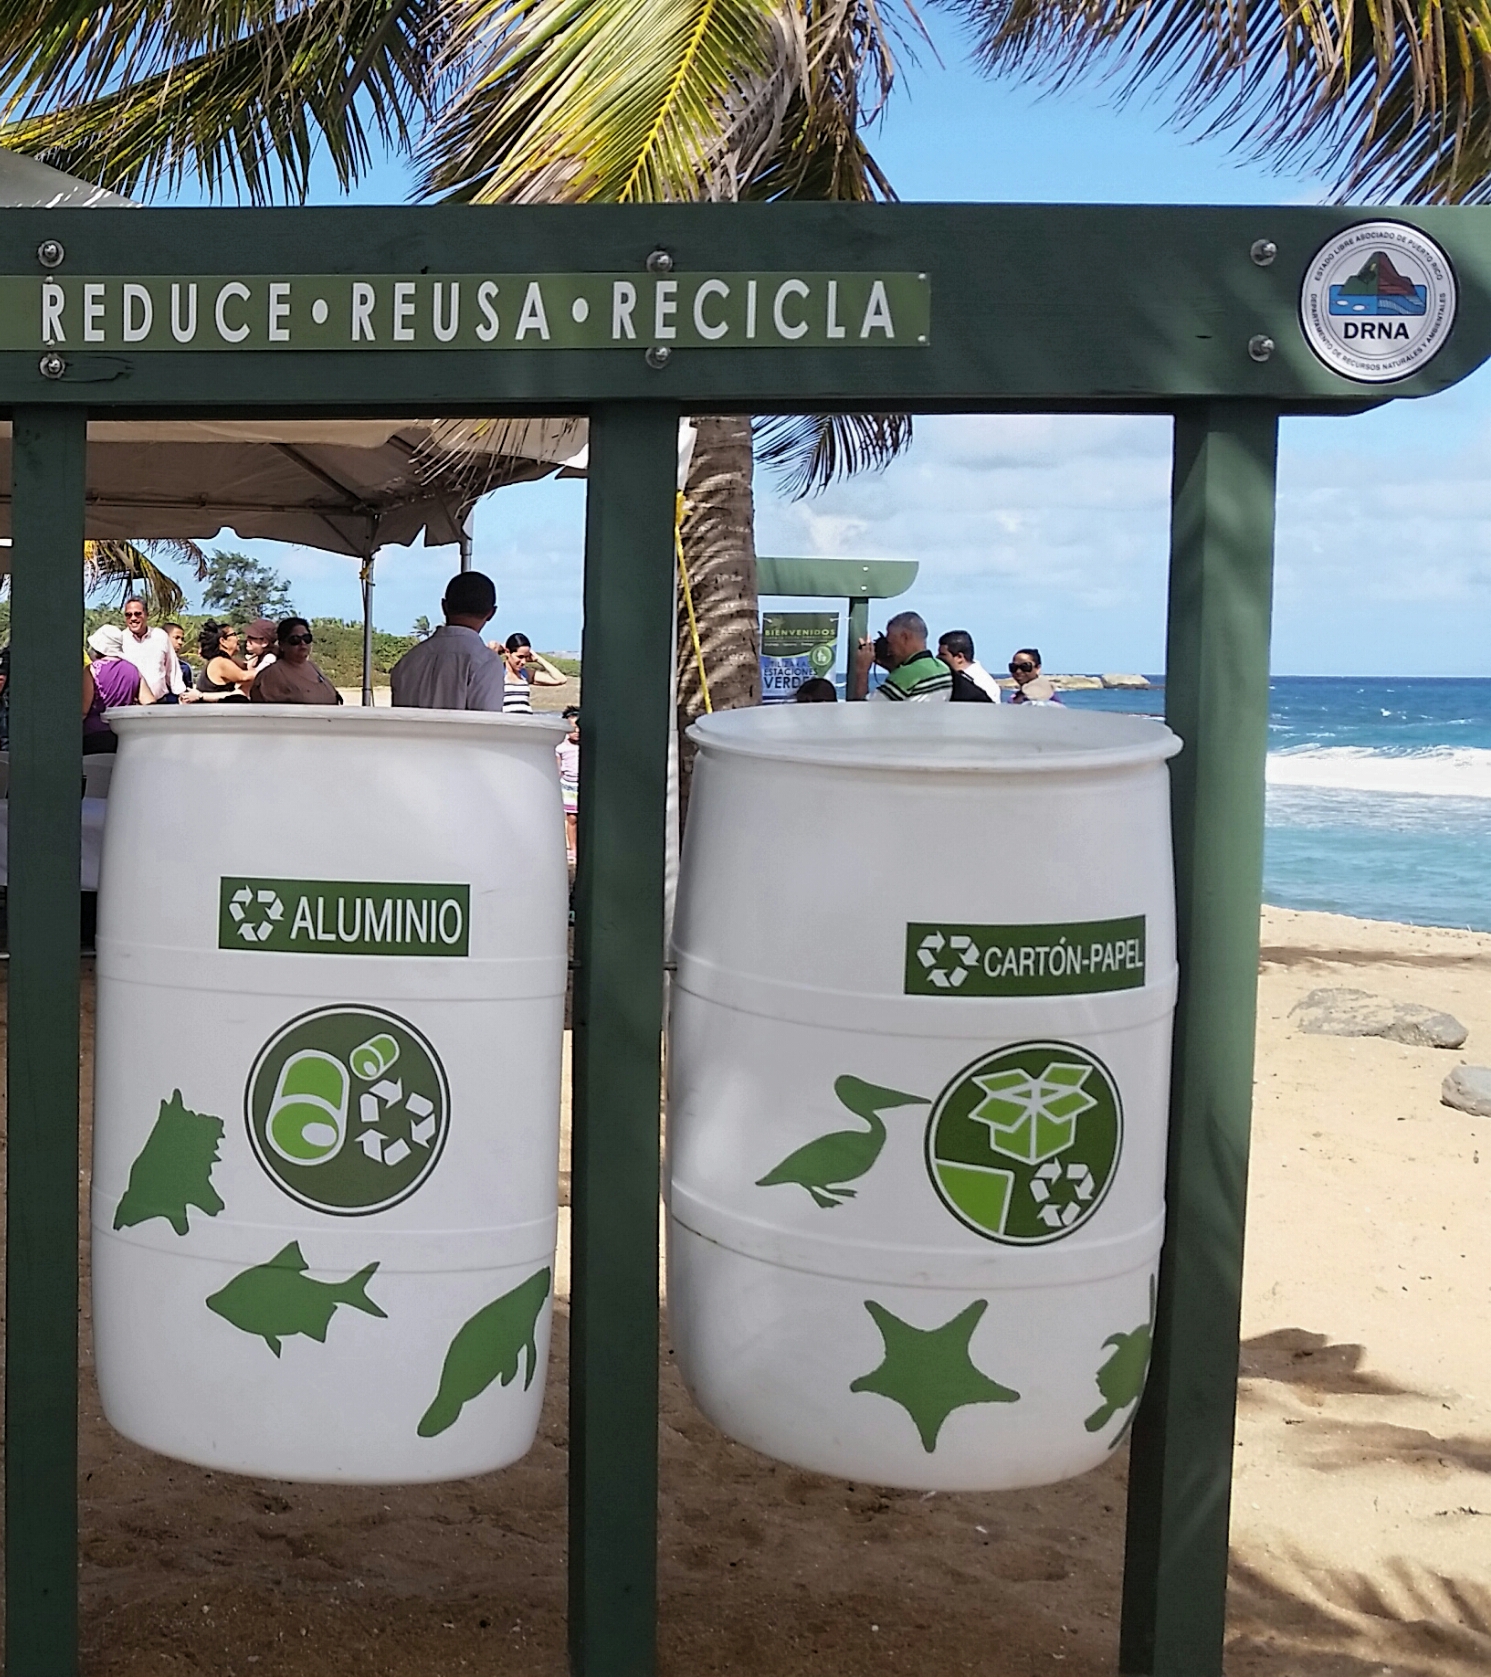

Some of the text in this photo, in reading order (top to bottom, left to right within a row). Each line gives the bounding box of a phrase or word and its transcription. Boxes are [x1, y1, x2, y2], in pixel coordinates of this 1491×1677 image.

[1314, 231, 1444, 282] ESTADO LIBRE ASOCIADO DE PUERTO RICO
[42, 281, 292, 346] REDUCE
[351, 280, 552, 343] REUSA
[612, 278, 896, 340] RECICLA
[1310, 293, 1333, 351] DEPARTAMENTO
[1331, 348, 1342, 358] DE
[1341, 355, 1381, 371] RECURSOS
[1382, 346, 1424, 371] NATURALES
[1426, 292, 1447, 345] AMBIENTALES
[1343, 321, 1410, 340] DRNA
[764, 628, 836, 636] BIENVENIDOS
[763, 667, 818, 676] ESTACIONES
[763, 676, 811, 689] VERD
[290, 895, 464, 945] ALUMINIO
[983, 936, 1144, 977] CARTÓN-PAPEL
